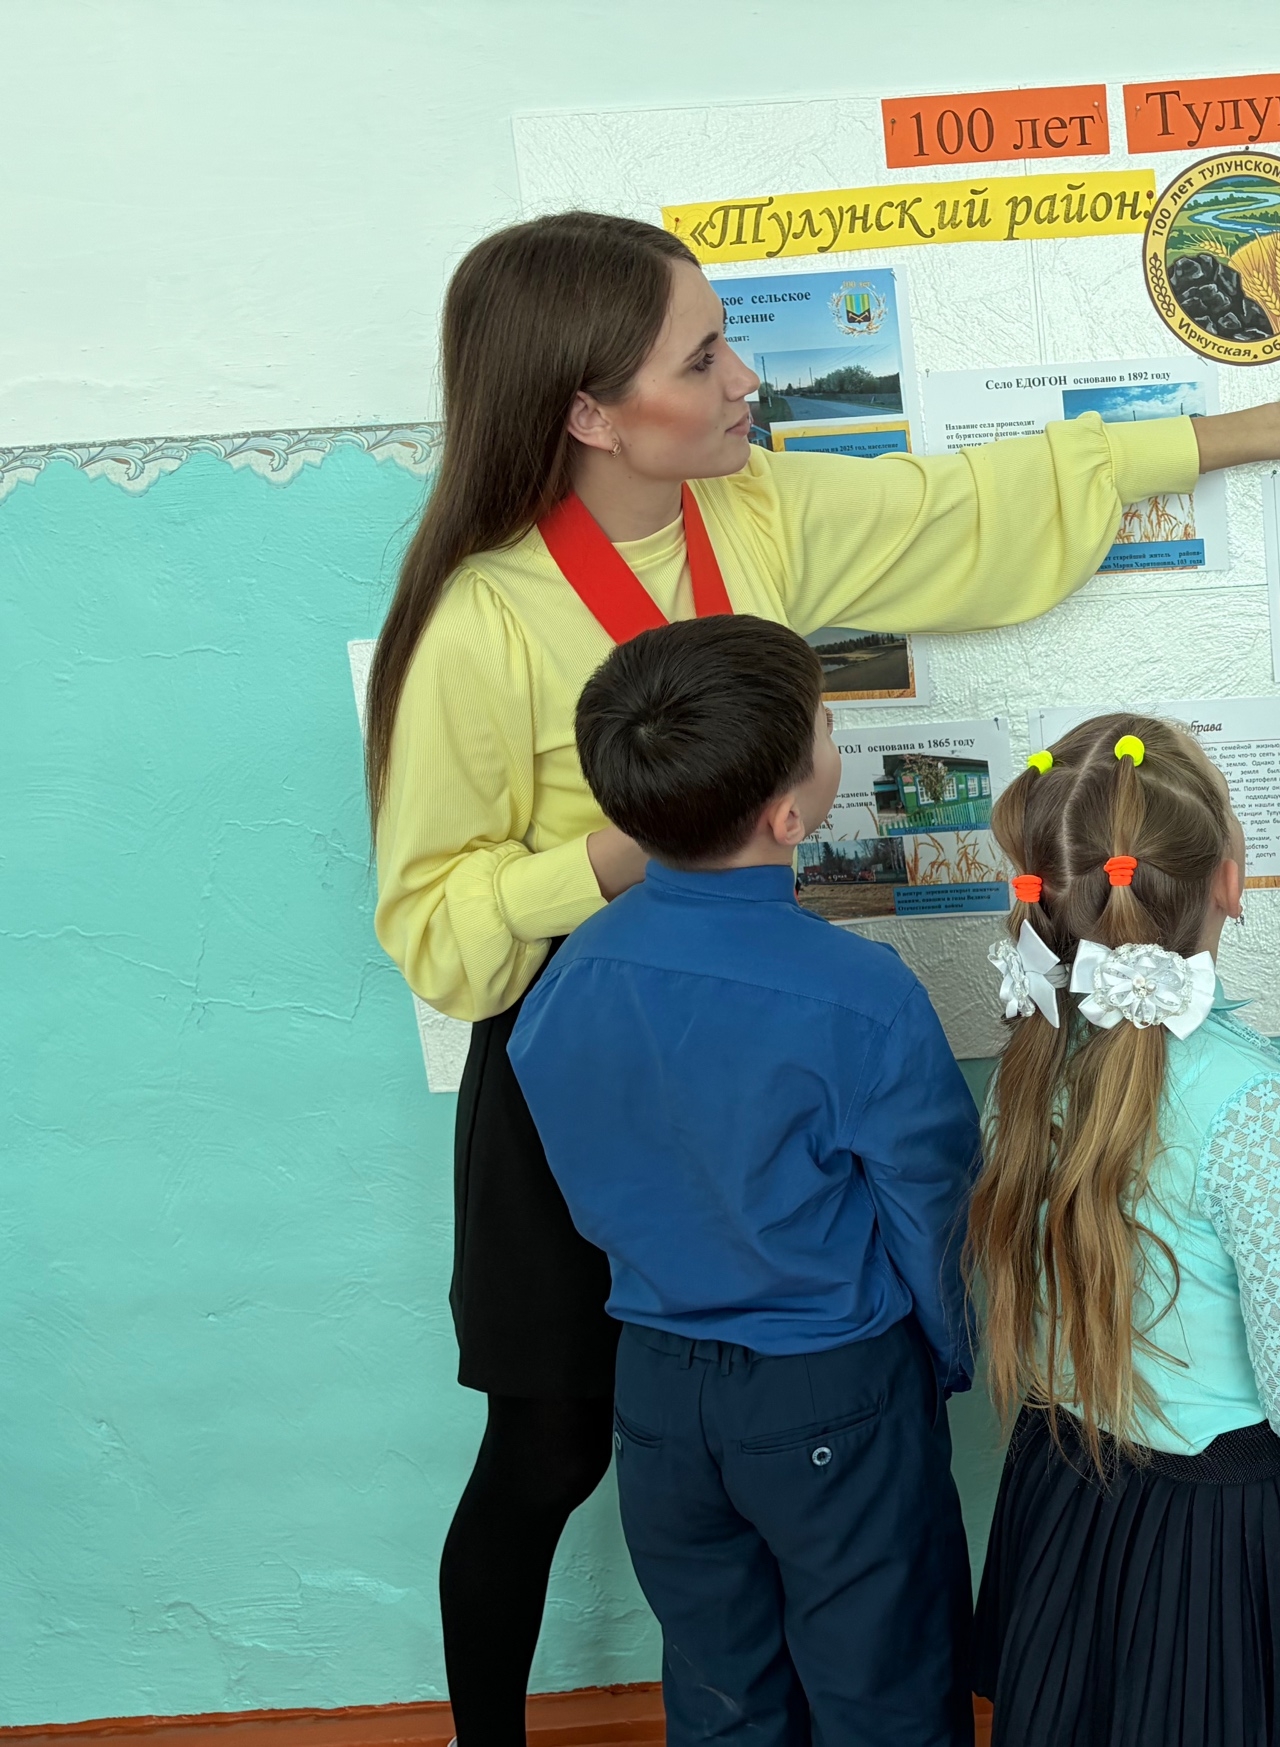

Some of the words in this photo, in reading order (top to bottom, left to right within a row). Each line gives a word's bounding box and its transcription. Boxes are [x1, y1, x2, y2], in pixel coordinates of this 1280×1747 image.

[909, 106, 995, 158] 100
[1012, 114, 1096, 150] лет
[1152, 207, 1172, 237] 100
[1170, 177, 1196, 206] лет
[688, 188, 990, 258] «Тулунский
[842, 280, 856, 288] 100
[751, 290, 812, 305] сельское
[723, 312, 776, 326] селение
[1178, 317, 1252, 358] Иркутская
[985, 379, 1013, 391] Село
[1016, 375, 1068, 389] ЕДОГОН
[1073, 375, 1117, 386] основано
[1119, 374, 1126, 383] в
[1128, 371, 1149, 381] 1892
[1151, 370, 1172, 380] году
[945, 422, 979, 431] Название
[979, 422, 995, 430] села
[996, 419, 1036, 431] происходит
[946, 433, 955, 441] от
[956, 431, 994, 442] бурятского
[1021, 428, 1045, 437] «шама
[1190, 720, 1223, 736] брава
[838, 744, 862, 755] ГОЛ
[867, 742, 916, 753] основана
[918, 741, 925, 749] в
[927, 738, 951, 749] 1865
[953, 737, 976, 747] году
[1221, 743, 1252, 751] семейной
[1251, 759, 1275, 767] Однако
[1245, 776, 1278, 784] картофеля
[1243, 785, 1270, 793] Поэтому
[1255, 851, 1276, 859] доступ
